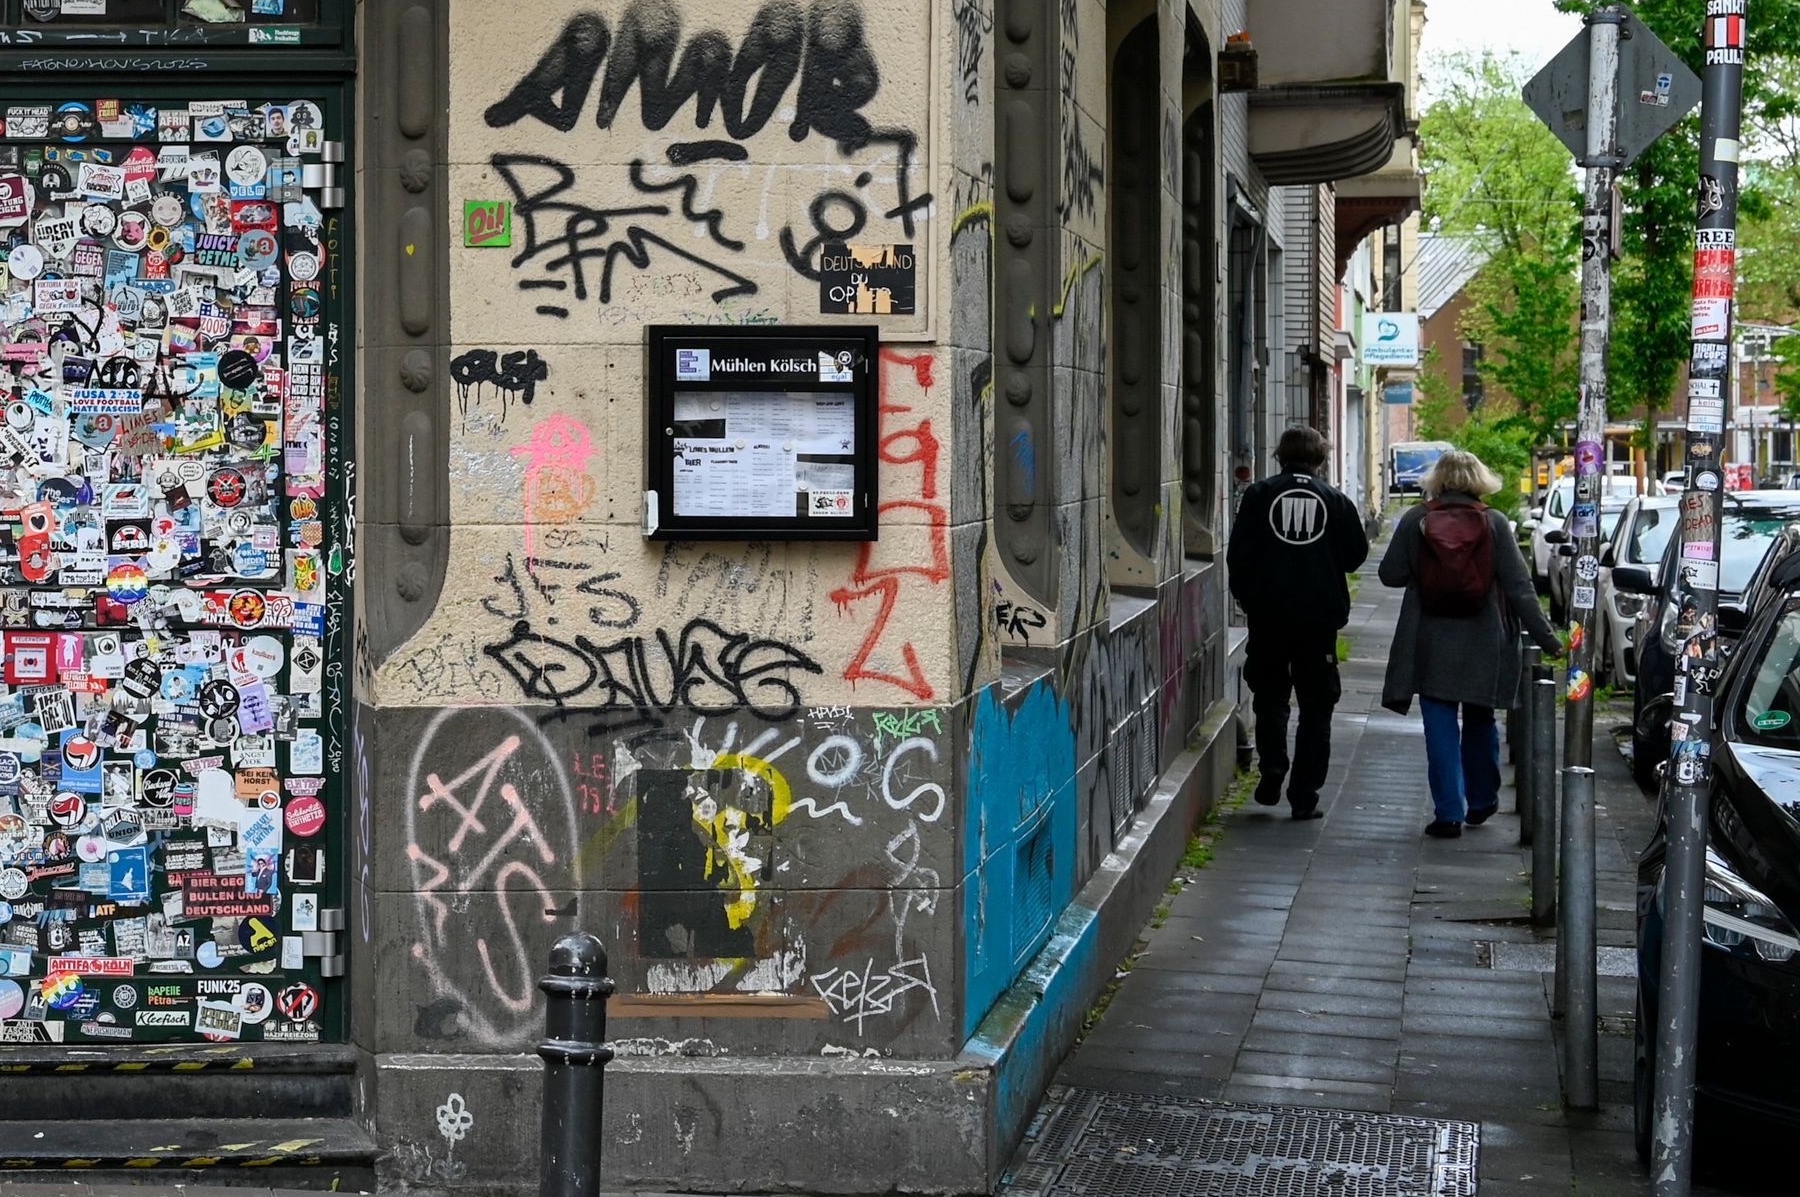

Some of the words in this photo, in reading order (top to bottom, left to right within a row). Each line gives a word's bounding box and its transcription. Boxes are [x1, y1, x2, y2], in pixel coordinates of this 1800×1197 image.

[159, 116, 189, 126] AFRIN
[467, 203, 505, 245] Oi!
[711, 358, 766, 372] Mühlen
[770, 358, 817, 372] Kölsch
[73, 390, 106, 399] #USA
[239, 751, 266, 759] ANGST
[243, 777, 271, 785] HORST
[242, 812, 271, 842] ABSOLUT
[251, 825, 276, 848] ANTIFA
[190, 877, 218, 887] BIER
[189, 890, 235, 901] BULLEN
[237, 890, 262, 900] UND
[185, 903, 270, 915] DEUTSCHLAND
[176, 934, 191, 947] AZ
[51, 959, 90, 971] ANTIFA
[103, 958, 132, 970] KÖLN
[197, 980, 241, 994] FUNK25
[137, 1011, 189, 1026] Kleefisch
